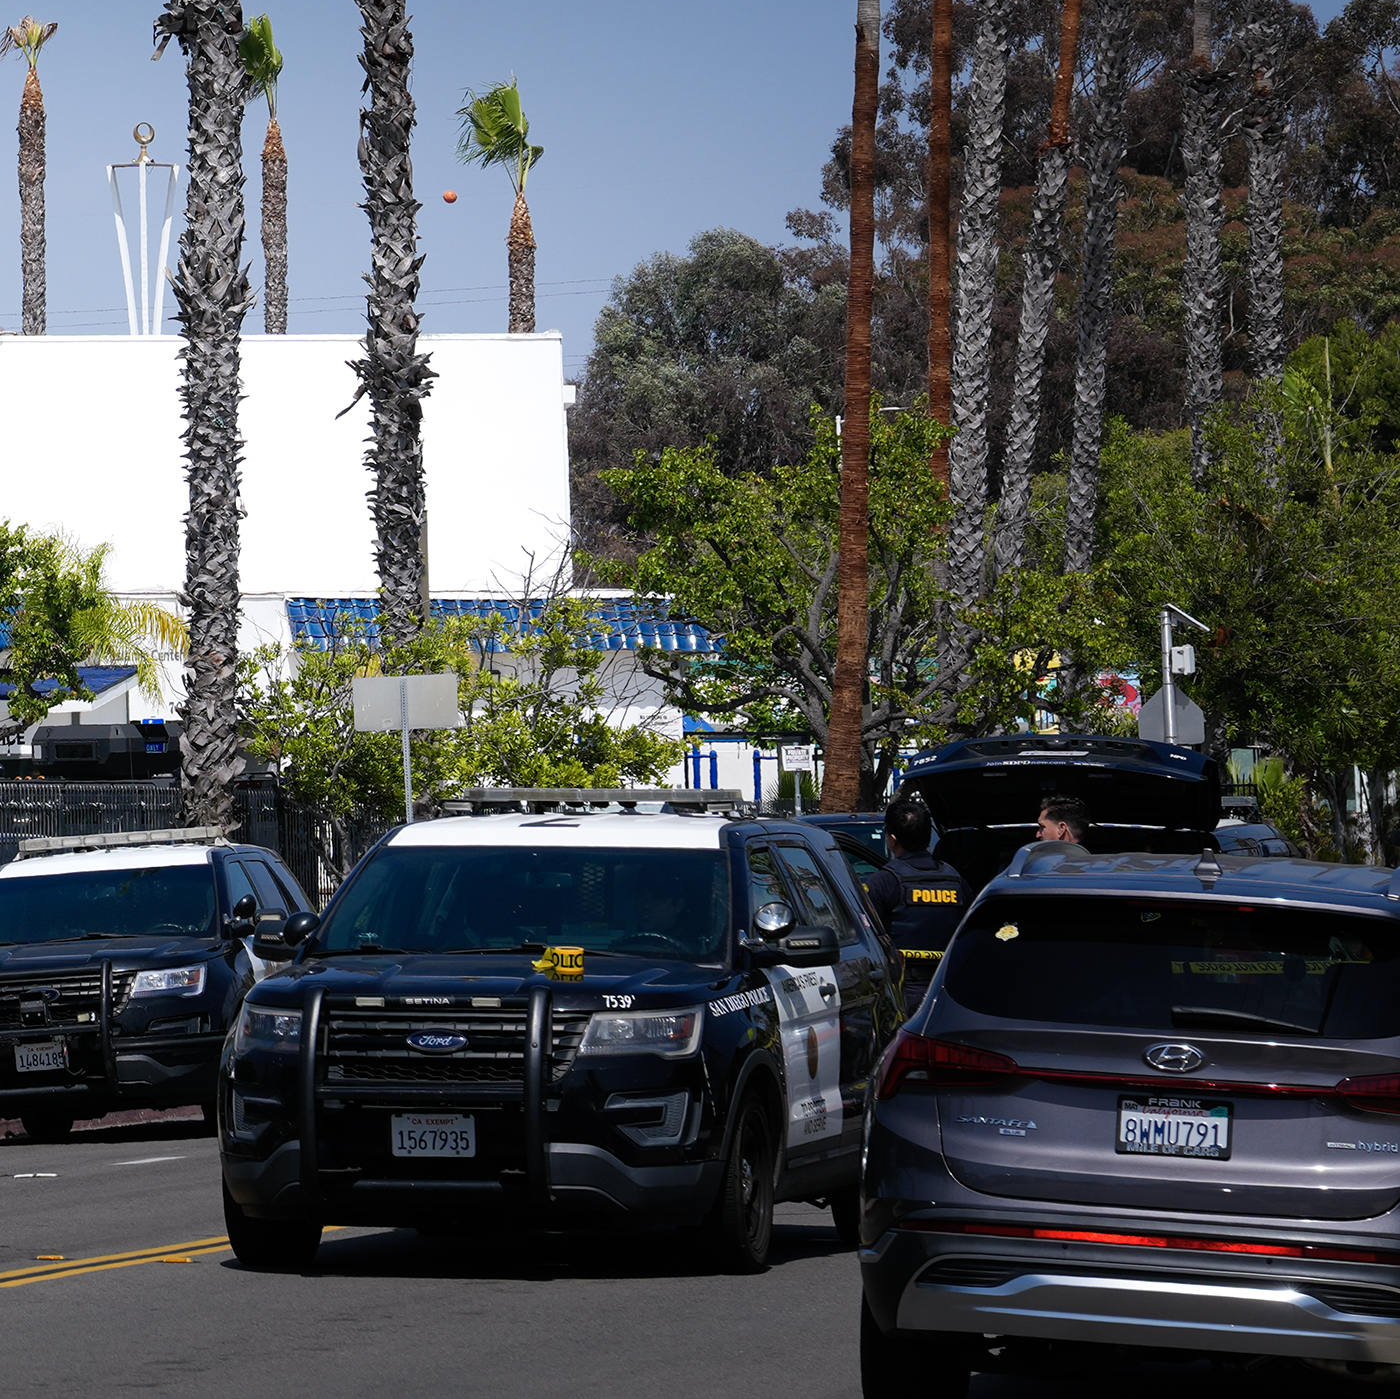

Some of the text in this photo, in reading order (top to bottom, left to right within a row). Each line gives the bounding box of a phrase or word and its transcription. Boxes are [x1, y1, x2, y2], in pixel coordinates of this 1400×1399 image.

[912, 889, 958, 903] POLICE
[708, 999, 730, 1017] SAN
[724, 993, 750, 1012] DIEGO
[418, 1035, 453, 1046] Ford
[426, 1118, 454, 1126] EXEMPT
[398, 1130, 470, 1150] 1567935
[1125, 1118, 1218, 1148] 8WMU791
[1126, 1142, 1219, 1157] MILE OF CARS
[1358, 1140, 1398, 1153] hybrid
